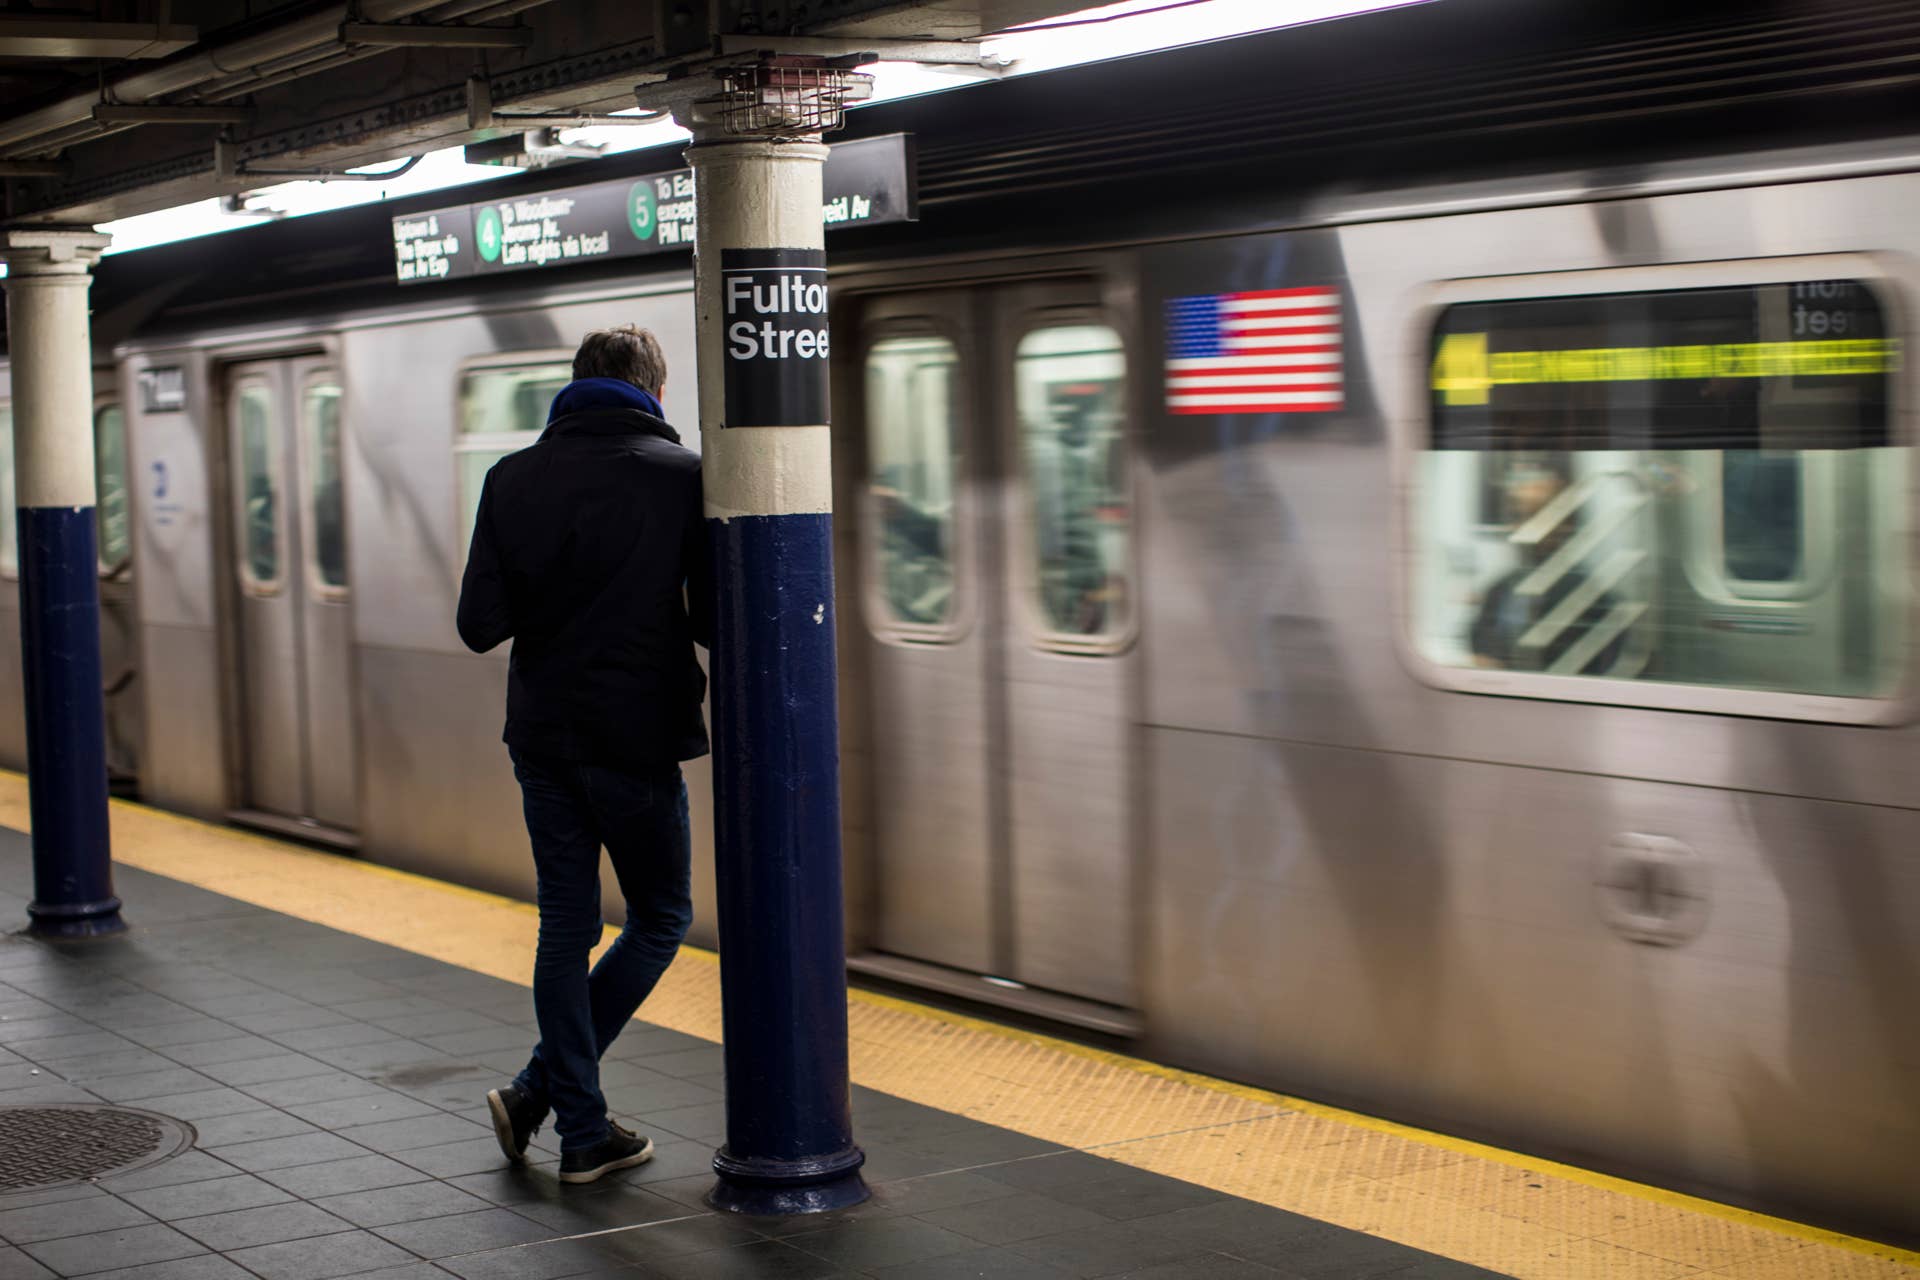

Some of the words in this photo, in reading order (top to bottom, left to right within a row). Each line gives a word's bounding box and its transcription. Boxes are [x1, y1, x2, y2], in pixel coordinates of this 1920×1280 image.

[655, 178, 671, 200] To
[673, 175, 693, 197] Ea
[499, 203, 515, 224] To
[636, 196, 649, 228] 5
[657, 201, 693, 222] excep
[823, 196, 849, 224] reid
[851, 194, 870, 219] Av
[482, 219, 495, 248] 4
[502, 243, 527, 265] Late
[528, 239, 561, 265] nights
[562, 236, 580, 257] via
[580, 230, 609, 255] local
[658, 222, 680, 245] PM
[681, 224, 695, 242] ru
[728, 321, 829, 360] Stree
